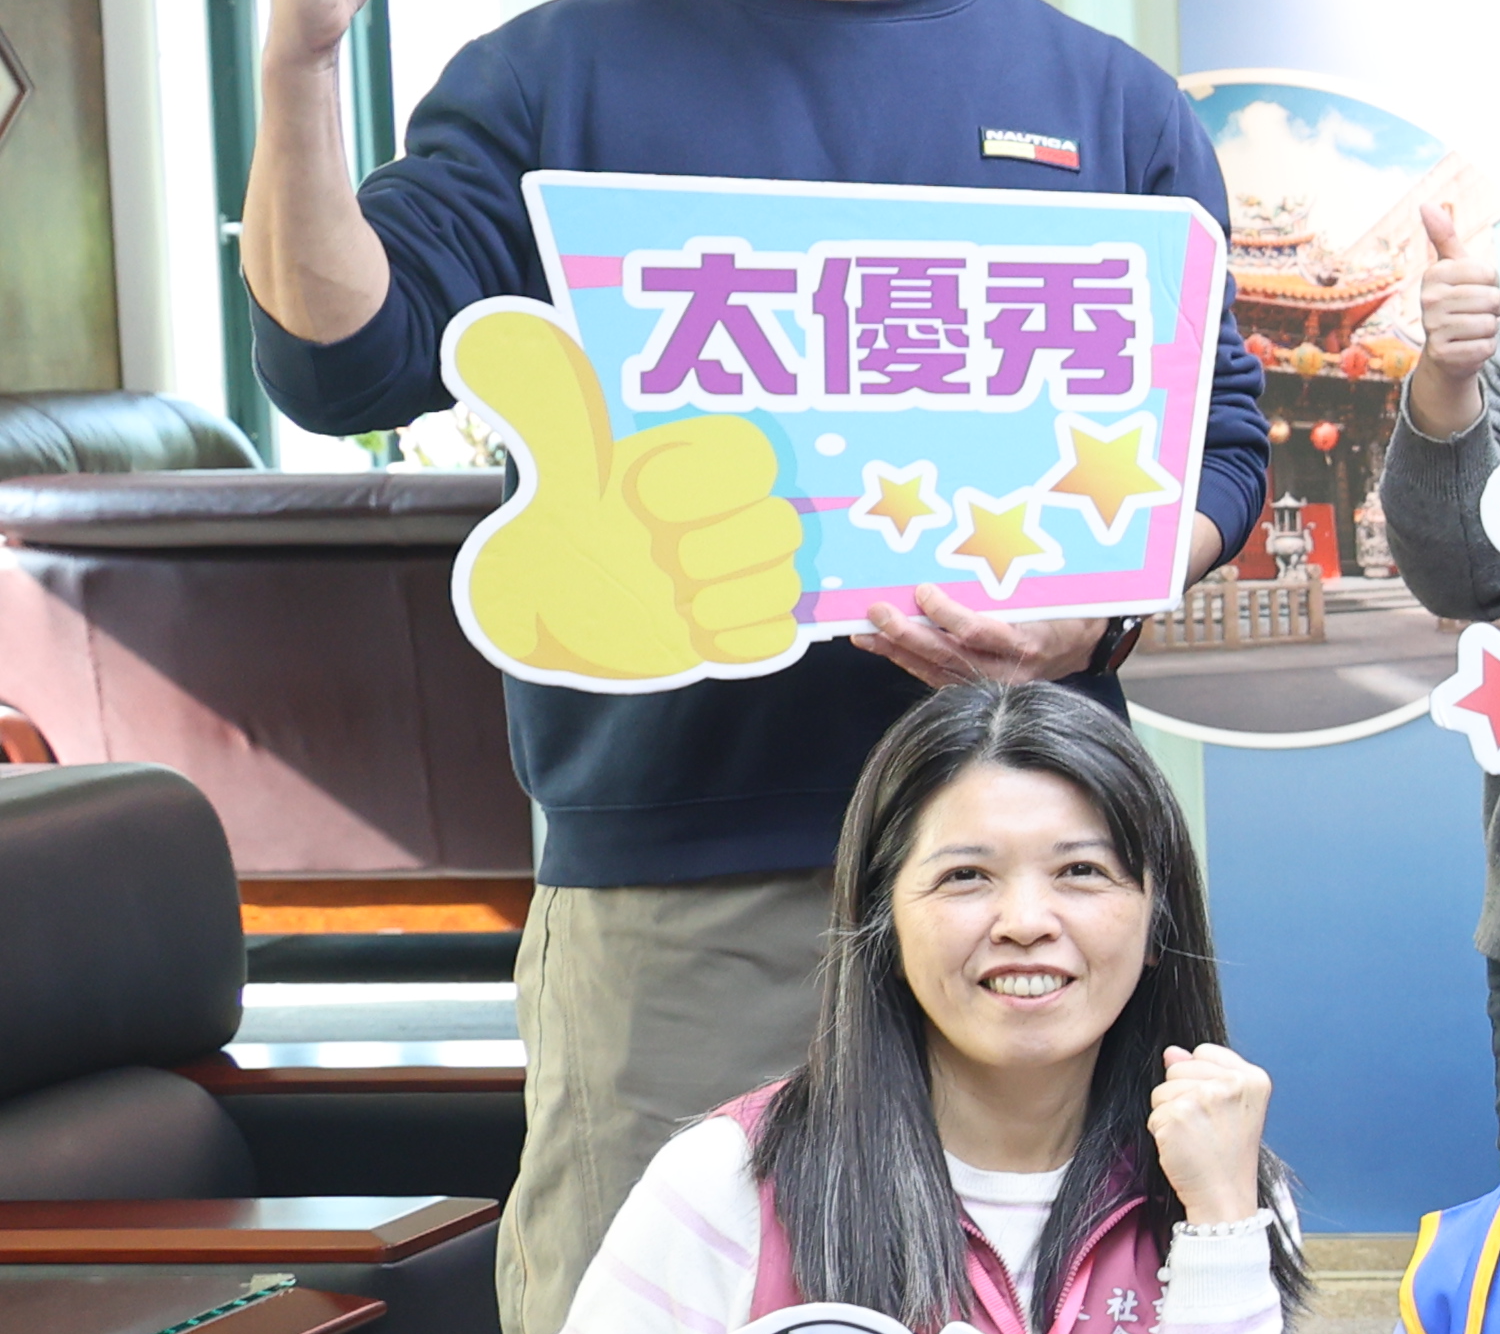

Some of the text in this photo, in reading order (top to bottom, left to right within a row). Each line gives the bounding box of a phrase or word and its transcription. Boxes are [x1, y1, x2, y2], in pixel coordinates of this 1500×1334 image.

[985, 129, 1077, 153] NAUTICA
[640, 253, 1135, 396] 太優秀
